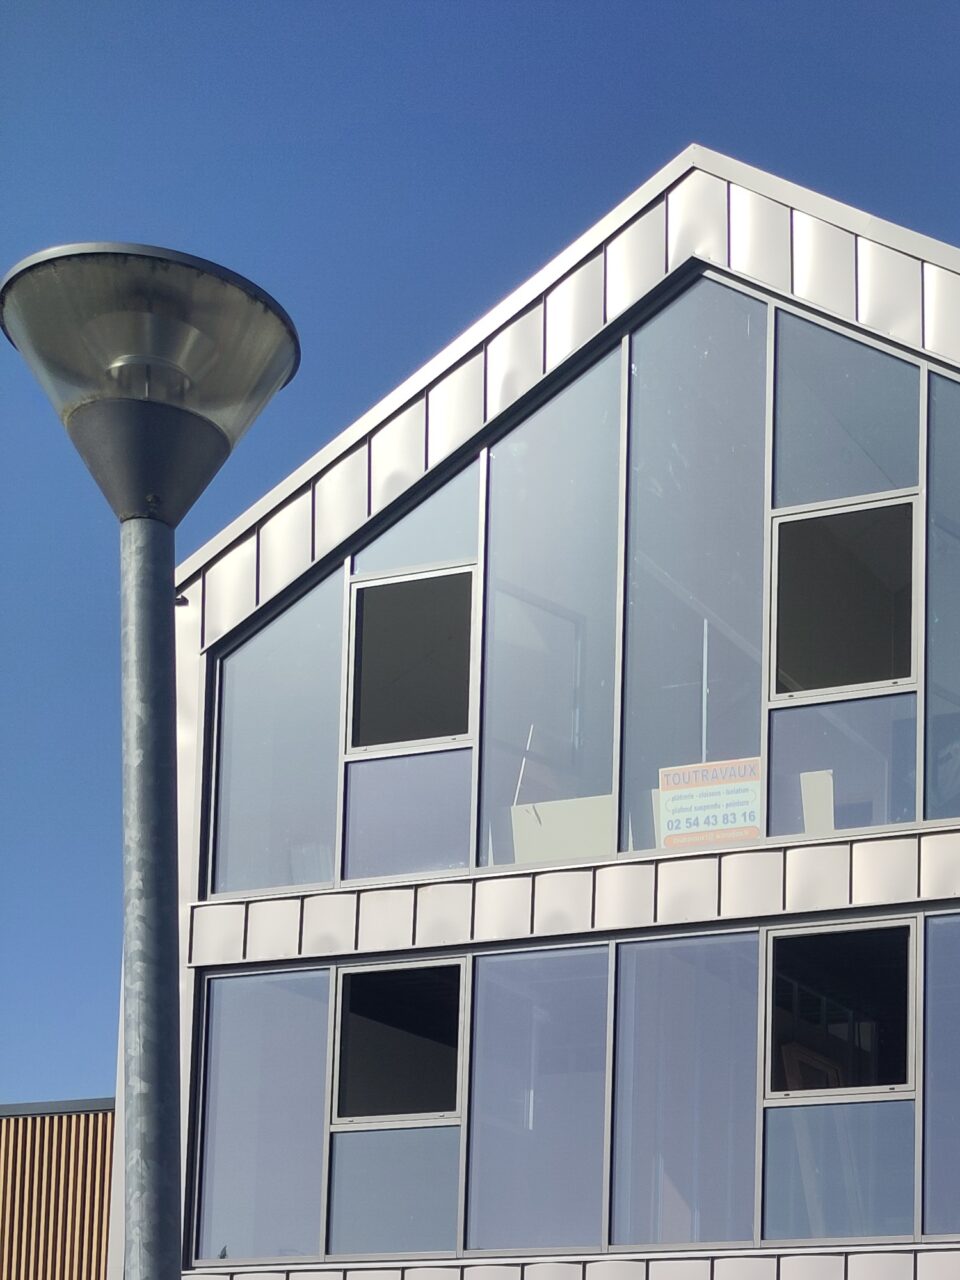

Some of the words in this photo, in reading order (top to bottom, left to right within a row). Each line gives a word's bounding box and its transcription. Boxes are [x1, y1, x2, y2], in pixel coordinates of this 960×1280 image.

[664, 764, 756, 786] TOUTRAVAUX
[667, 819, 681, 831] 02
[686, 816, 699, 829] 54
[703, 814, 718, 827] 43
[722, 812, 737, 825] 83
[741, 810, 756, 823] 16
